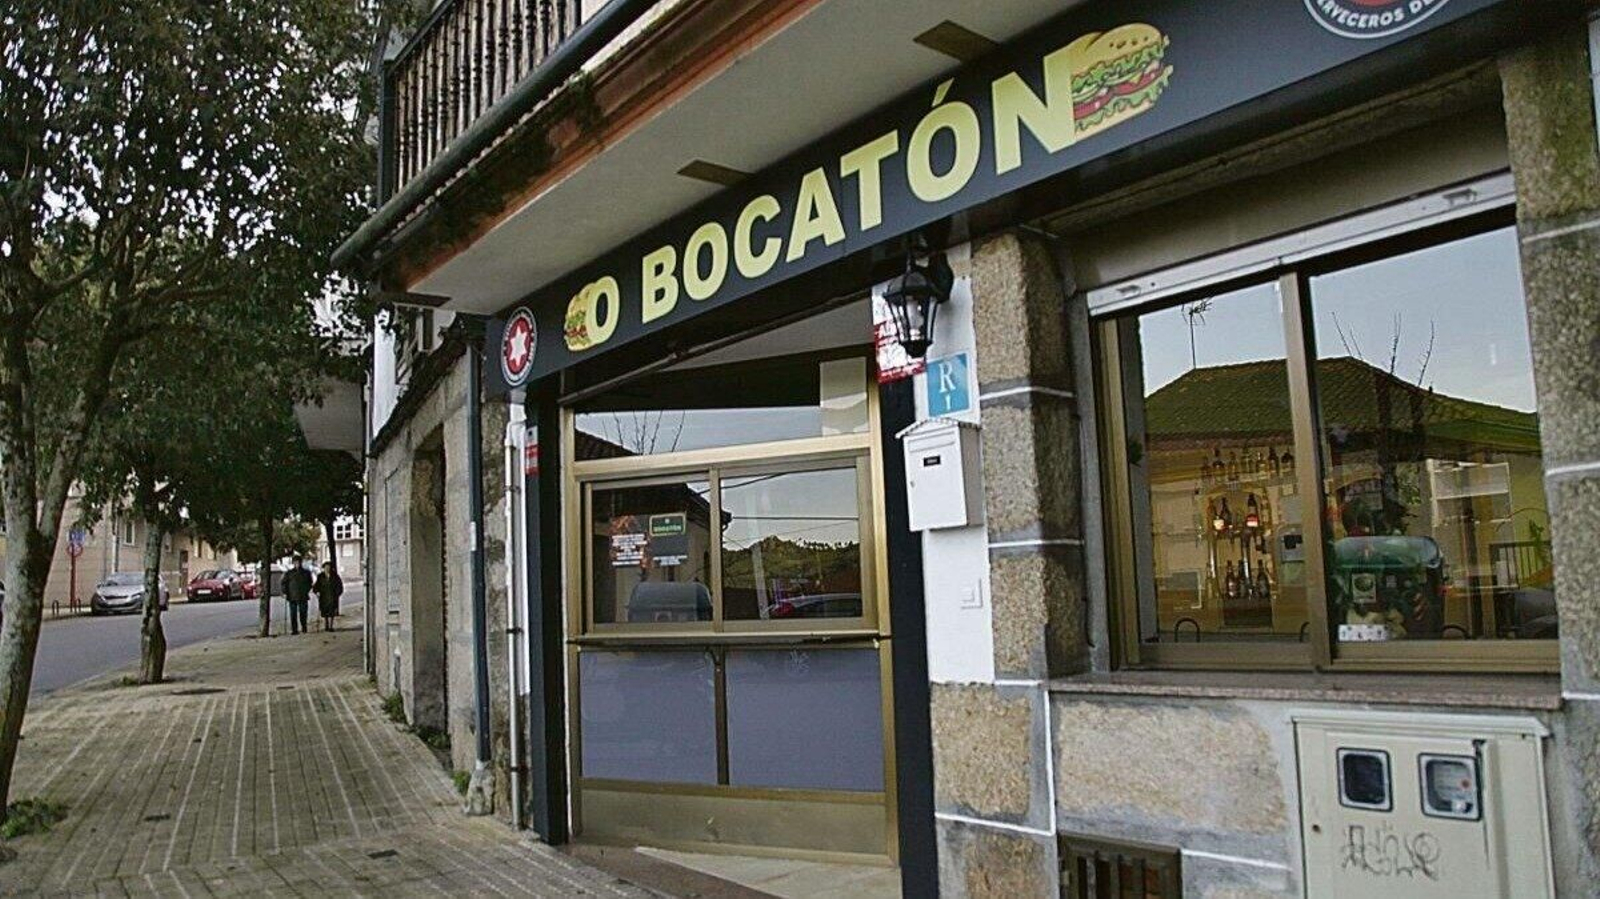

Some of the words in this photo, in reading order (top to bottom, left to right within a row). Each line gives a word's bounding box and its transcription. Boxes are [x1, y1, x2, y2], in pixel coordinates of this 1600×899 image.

[586, 276, 620, 344] O
[642, 50, 1076, 324] BOCATÓN
[938, 361, 957, 393] R
